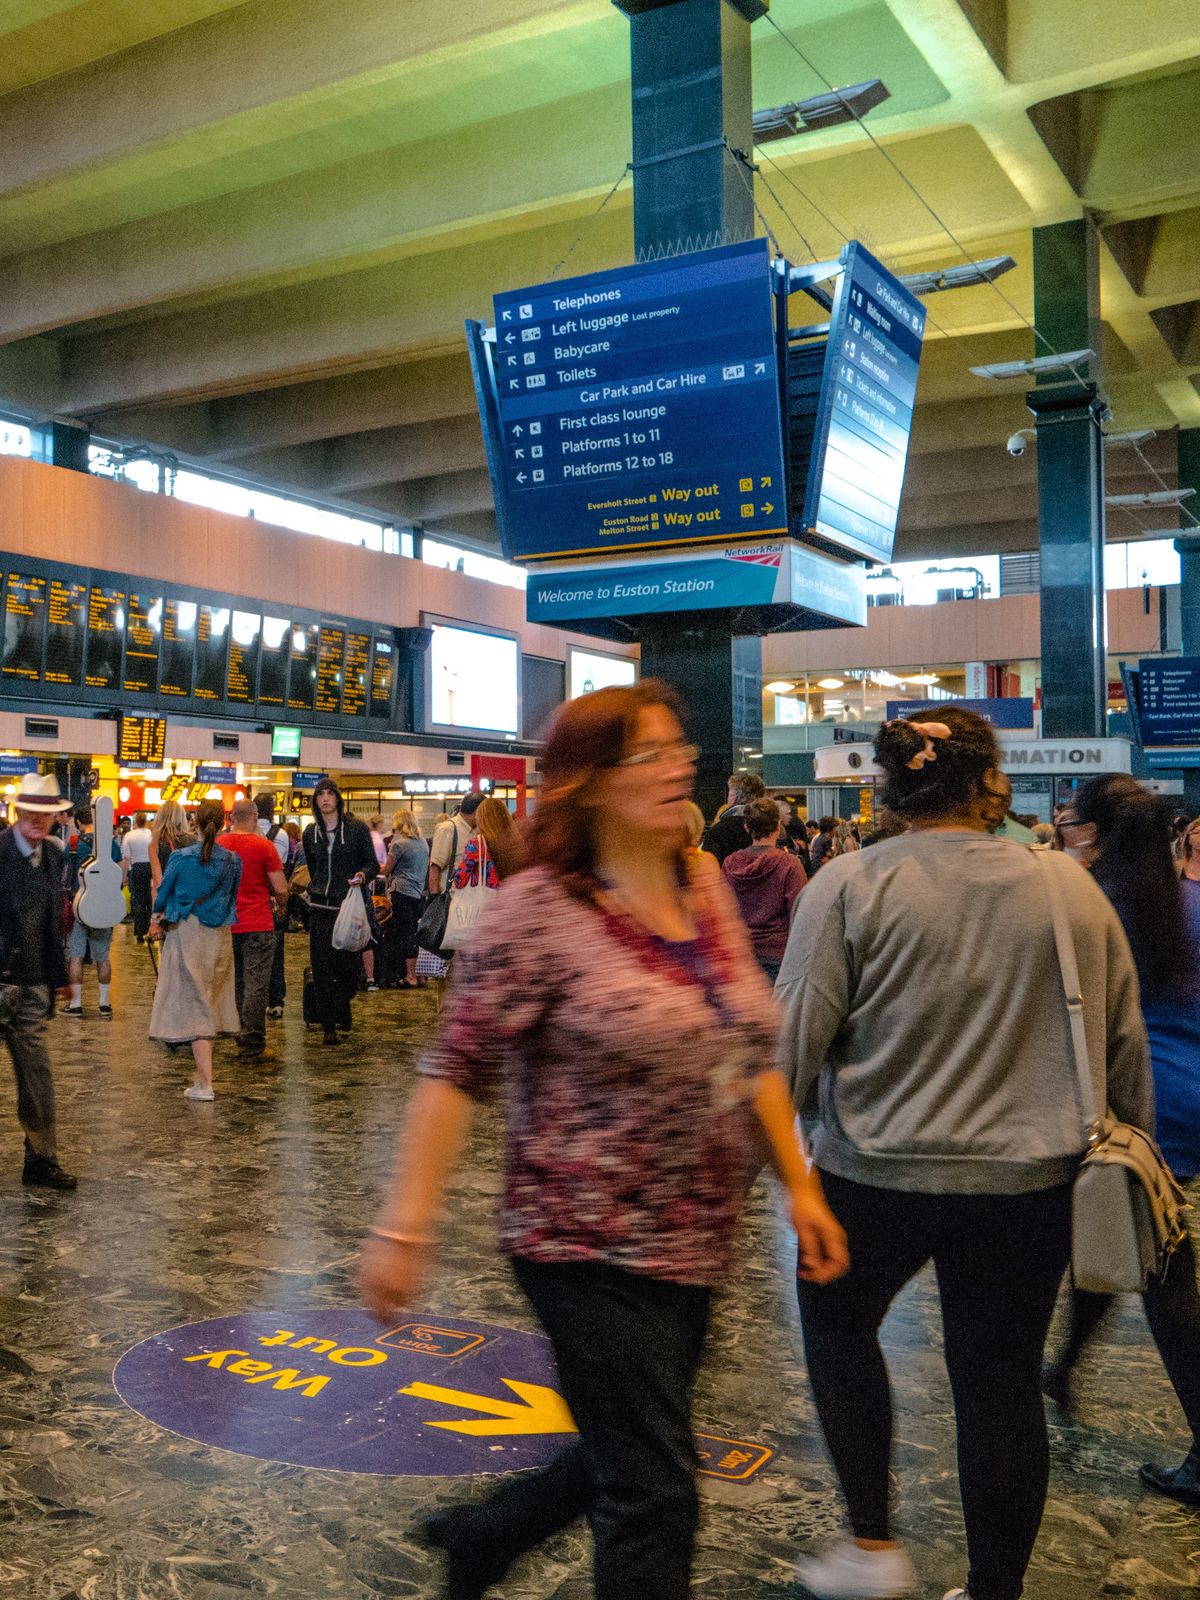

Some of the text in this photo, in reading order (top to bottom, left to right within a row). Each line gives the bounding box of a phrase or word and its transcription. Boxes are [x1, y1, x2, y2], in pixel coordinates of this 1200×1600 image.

[553, 289, 621, 311] Telephones
[552, 305, 680, 337] Left luggage Lost property
[554, 340, 610, 361] Babycare
[557, 366, 597, 384] Toilets
[580, 390, 600, 404] Car
[603, 385, 629, 400] Park
[631, 380, 653, 395] and
[656, 378, 677, 391] Car
[680, 372, 706, 387] Hire
[560, 405, 666, 431] First class lounge
[561, 428, 661, 454] Platforms 1 to 11
[563, 451, 673, 478] Platforms 12 to 18
[587, 484, 719, 511] Eversholt Street Way out
[599, 525, 624, 536] Melton
[626, 522, 650, 533] Street
[603, 516, 629, 526] Euston
[630, 514, 649, 524] Road
[664, 508, 720, 526] Way out
[538, 577, 714, 604] Welcome to Euston Station
[404, 779, 426, 793] THE
[427, 779, 457, 793] BODY
[258, 1329, 388, 1367] Out
[400, 1338, 442, 1352] 20m
[182, 1349, 332, 1398] Way
[717, 1449, 753, 1469] 20m
